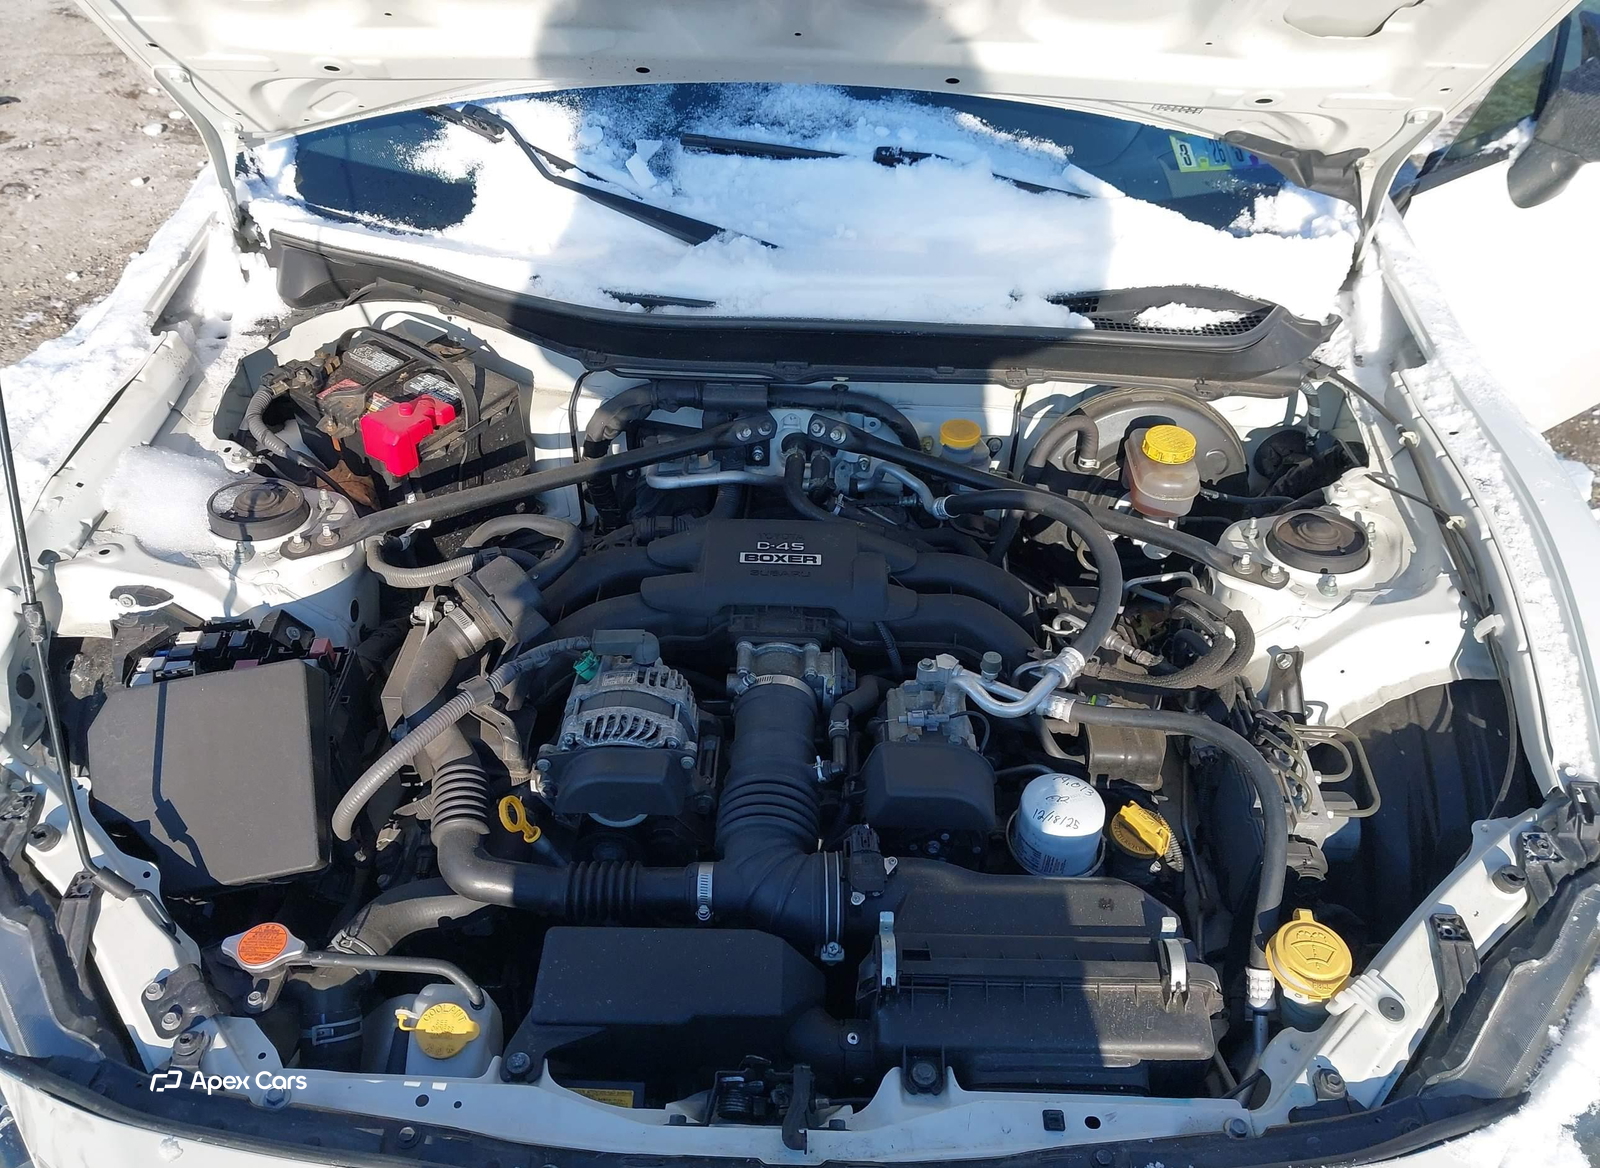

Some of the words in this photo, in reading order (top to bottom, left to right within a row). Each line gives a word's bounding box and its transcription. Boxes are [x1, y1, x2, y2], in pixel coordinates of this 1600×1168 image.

[1179, 144, 1192, 166] 3
[758, 532, 804, 540] TOYOTA
[757, 541, 805, 551] D-4S
[744, 553, 818, 564] BOXER
[750, 569, 811, 578] SUBARU
[1032, 808, 1081, 830] 12/18/25
[423, 1004, 467, 1022] COOLANT
